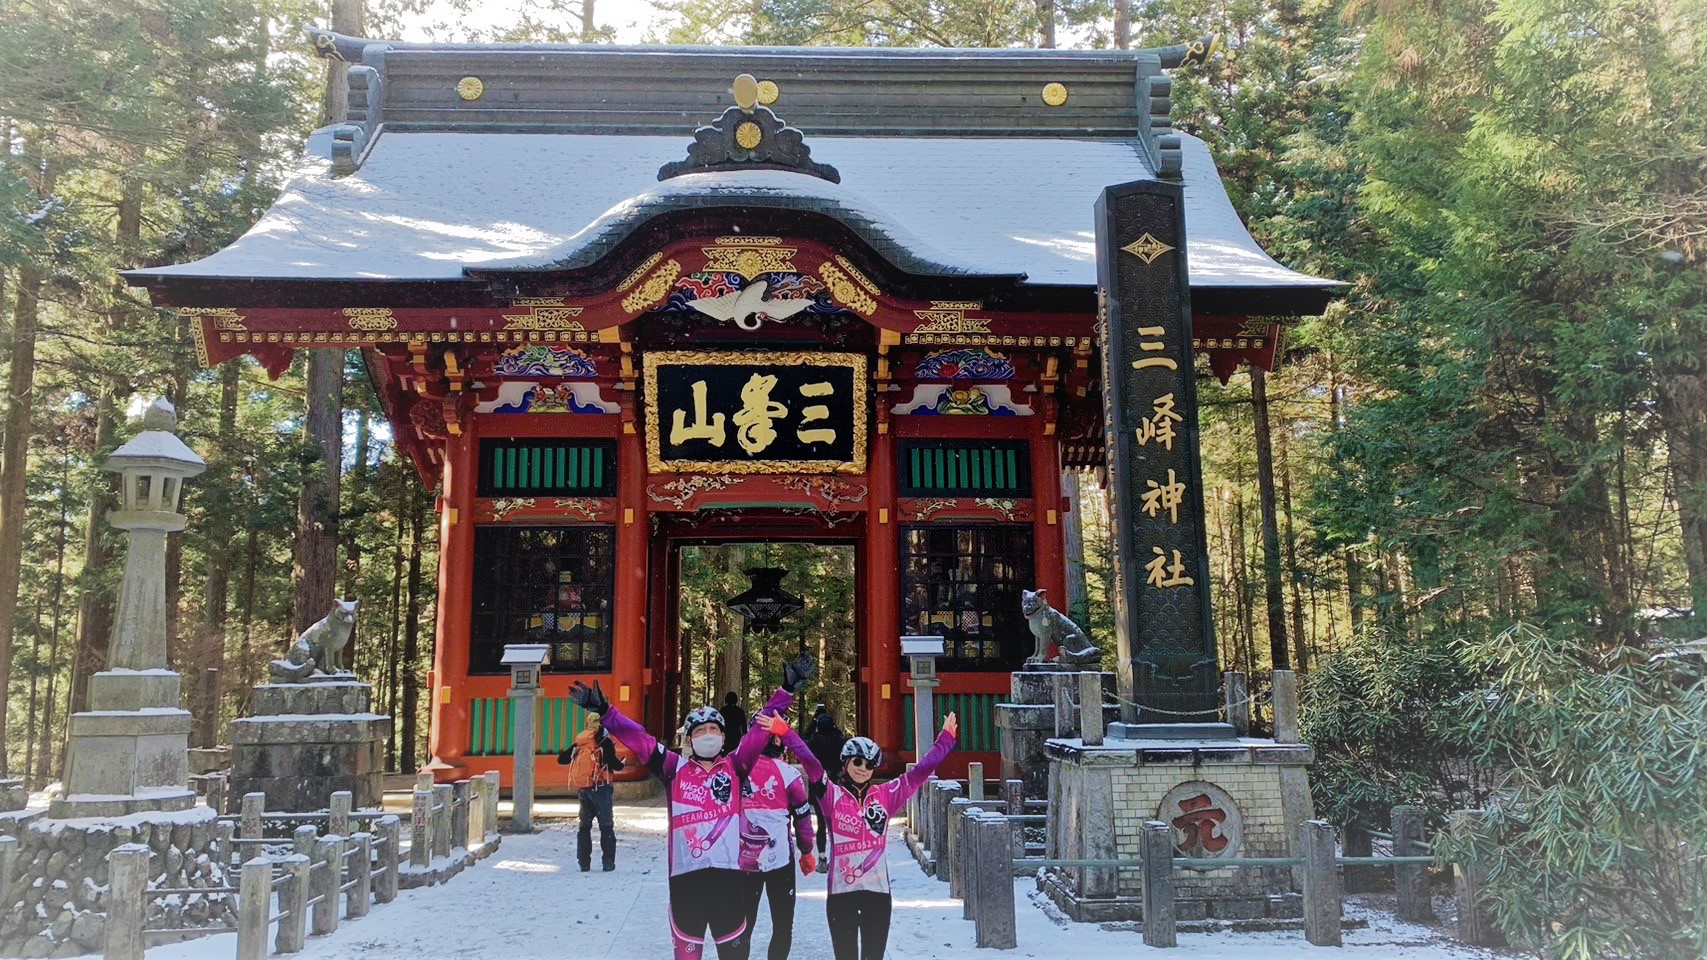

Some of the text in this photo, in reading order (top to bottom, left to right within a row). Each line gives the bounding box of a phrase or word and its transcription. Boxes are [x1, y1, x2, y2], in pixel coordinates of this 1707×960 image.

[1131, 324, 1195, 589] 三峰神社
[682, 791, 706, 804] RIDING
[1171, 793, 1229, 853] 元
